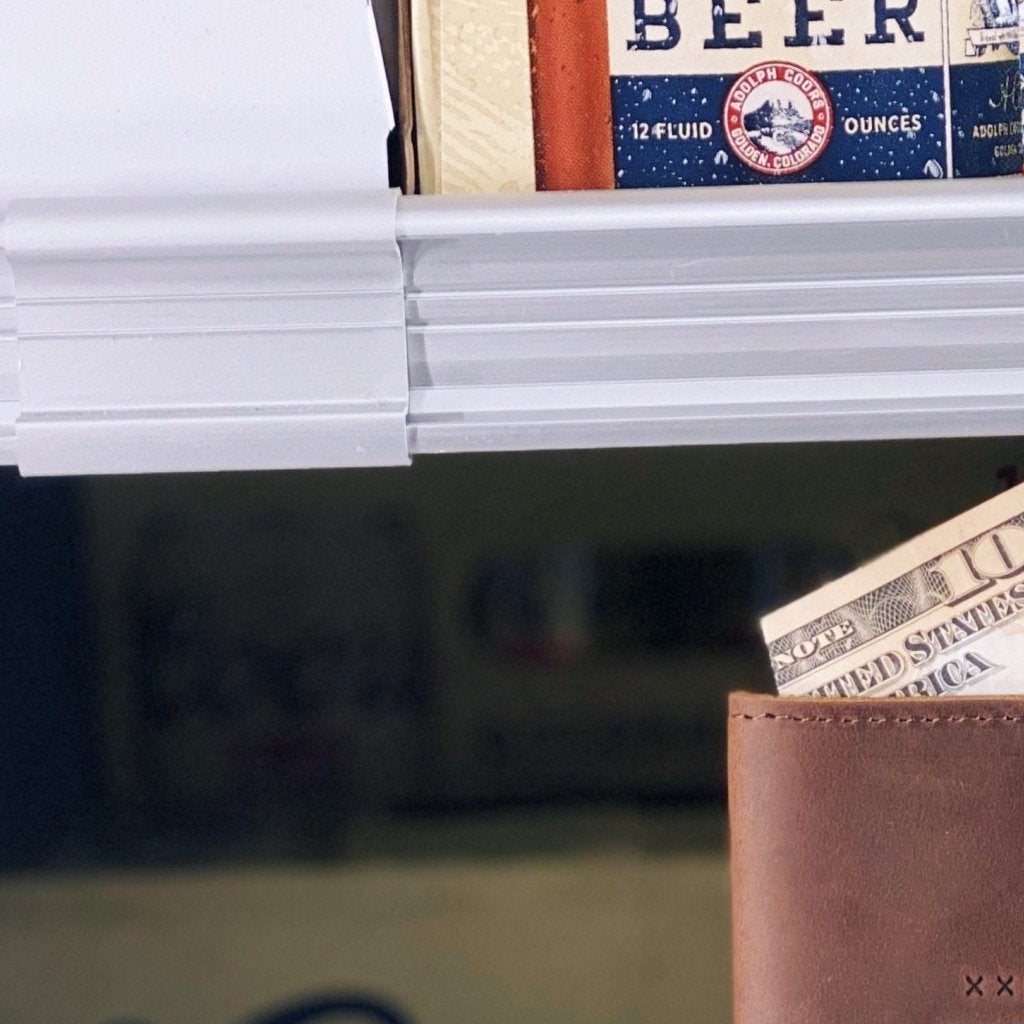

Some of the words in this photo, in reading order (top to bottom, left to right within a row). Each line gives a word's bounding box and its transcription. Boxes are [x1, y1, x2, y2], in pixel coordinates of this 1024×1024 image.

[627, 0, 925, 50] BEER
[730, 67, 777, 111] ADOLPH
[784, 68, 825, 110] COORS
[631, 123, 650, 140] 12
[656, 122, 713, 140] FLUID
[845, 114, 921, 134] OUNCES
[773, 125, 826, 169] COLORADO
[772, 620, 857, 671] NOTE
